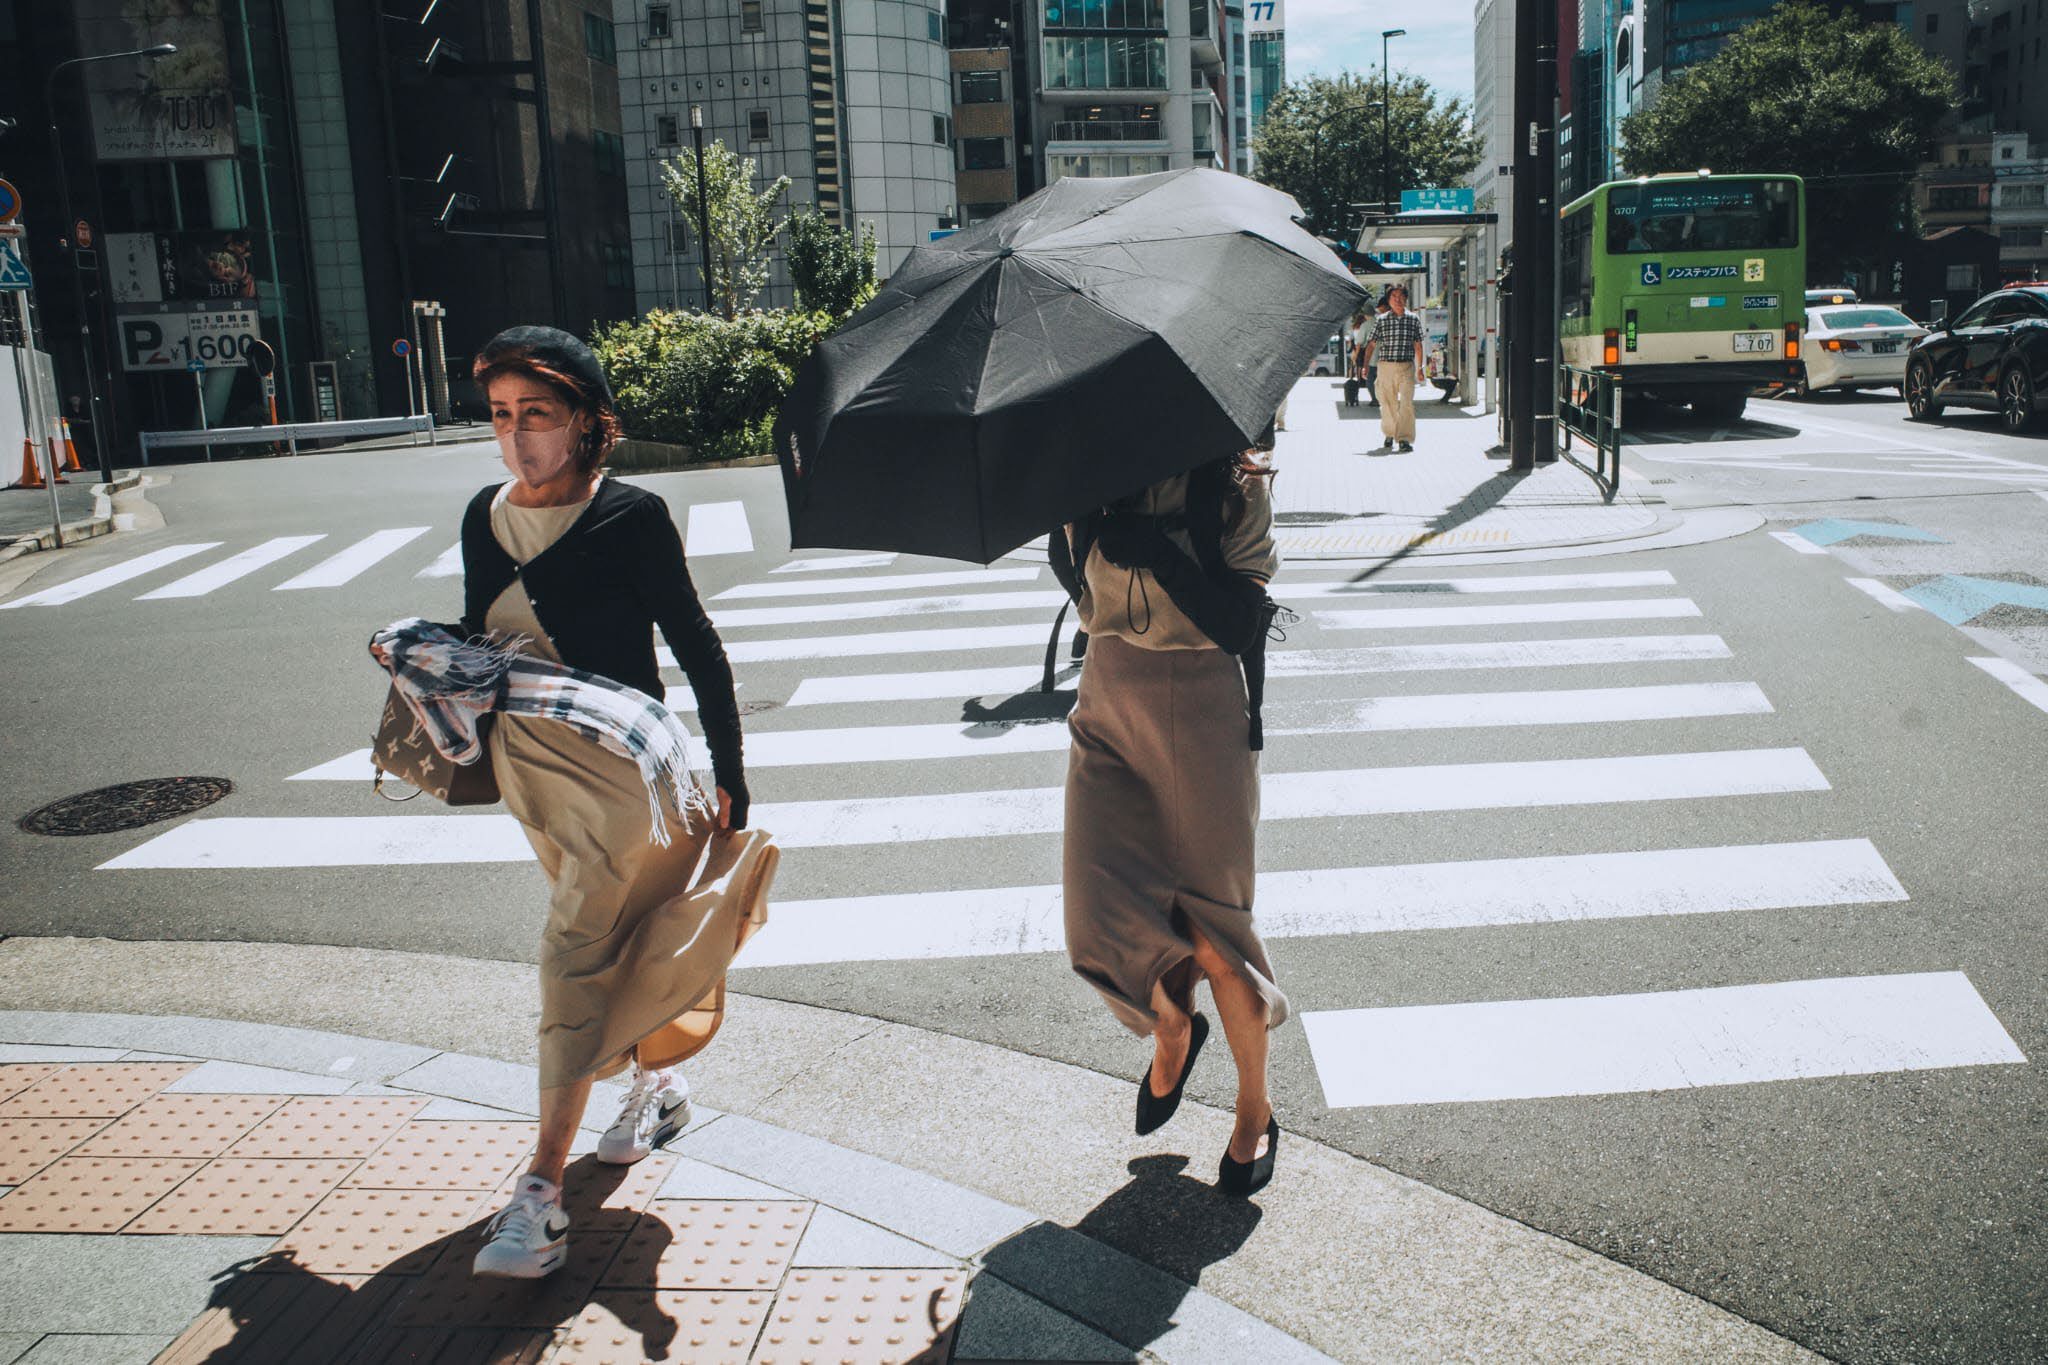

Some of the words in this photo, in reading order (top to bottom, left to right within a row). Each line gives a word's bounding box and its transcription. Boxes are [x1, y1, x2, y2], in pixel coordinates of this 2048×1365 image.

[1250, 2, 1275, 21] 77
[201, 134, 216, 148] 2F
[1667, 266, 1738, 279] ノンステップバス
[123, 320, 163, 365] P
